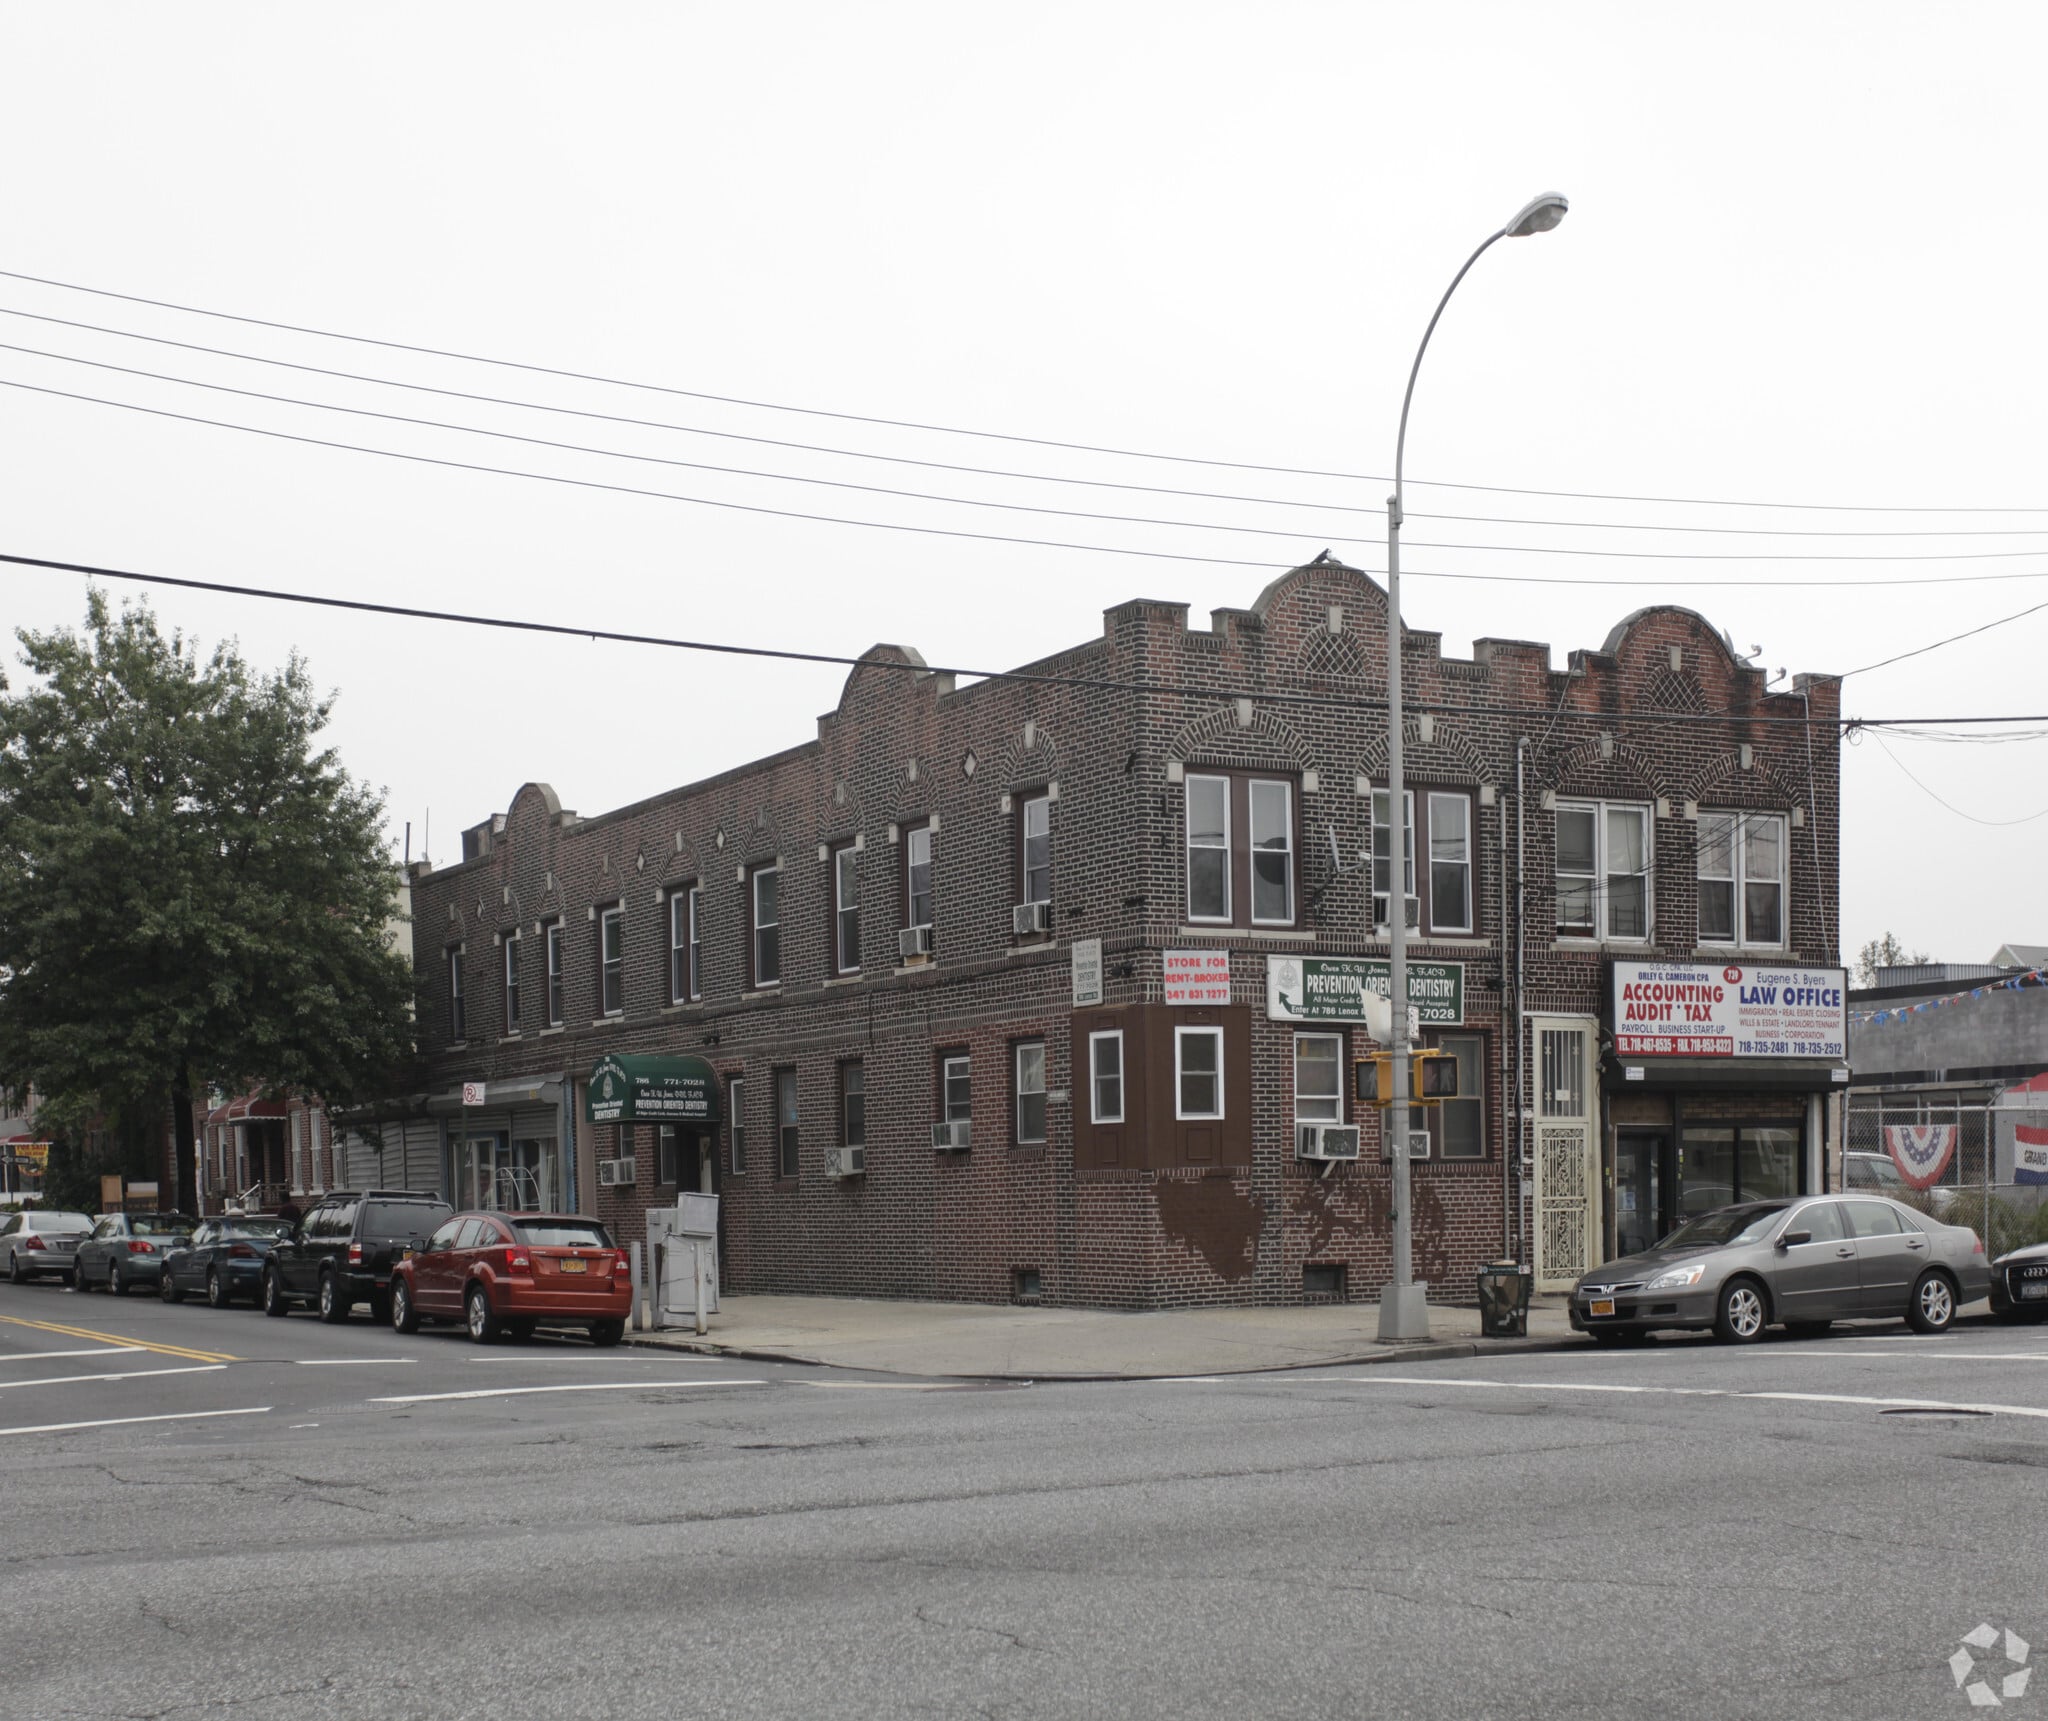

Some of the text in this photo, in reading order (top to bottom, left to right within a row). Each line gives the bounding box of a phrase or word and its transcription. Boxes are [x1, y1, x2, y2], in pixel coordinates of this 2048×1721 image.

[1168, 957, 1226, 968] STORE FOR
[1321, 963, 1339, 972] Owen
[1638, 972, 1657, 981] ORLEY
[1665, 972, 1696, 982] CAMERON
[1696, 973, 1709, 982] CPA
[1757, 972, 1826, 987] Eugene S. Byers
[1307, 974, 1455, 997] PREVENTION ORIEN DENTISTRY
[1167, 990, 1185, 999] 347
[1623, 983, 1724, 1003] ACCOUNTING
[1740, 986, 1841, 1007] LAW OFFICE
[1291, 1005, 1309, 1014] Enter
[1311, 1006, 1319, 1014] At
[1322, 1006, 1336, 1015] 786
[1338, 1007, 1359, 1016] Lenox
[1420, 1008, 1456, 1020] -7028
[1625, 1003, 1712, 1021] AUDIT TAX
[1739, 1007, 1840, 1018] IMMIGRATION REAL ESTATE CLOSING
[1740, 1018, 1755, 1027] WILLS
[1762, 1019, 1780, 1027] ESTATE
[1621, 1024, 1726, 1034] PAYROLL BUSINESS START-UP
[1755, 1030, 1825, 1039] BUSINESS CORPORATION
[1738, 1041, 1842, 1054] 718-735-2481 718-735-2512
